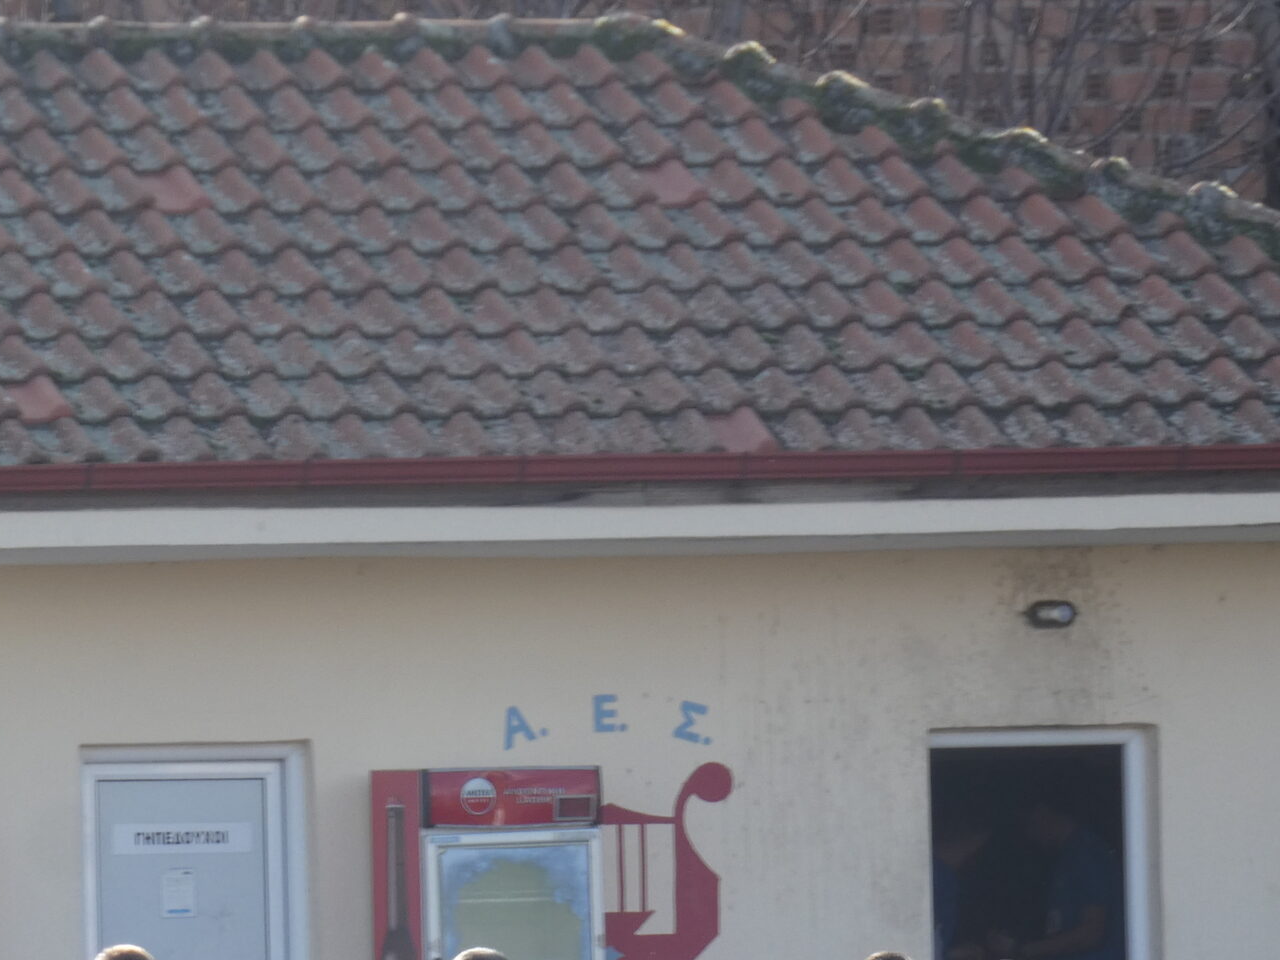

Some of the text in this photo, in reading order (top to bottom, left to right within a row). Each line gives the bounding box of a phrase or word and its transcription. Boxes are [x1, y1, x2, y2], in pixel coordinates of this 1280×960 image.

[503, 694, 712, 750] Α. Ε. Σ.
